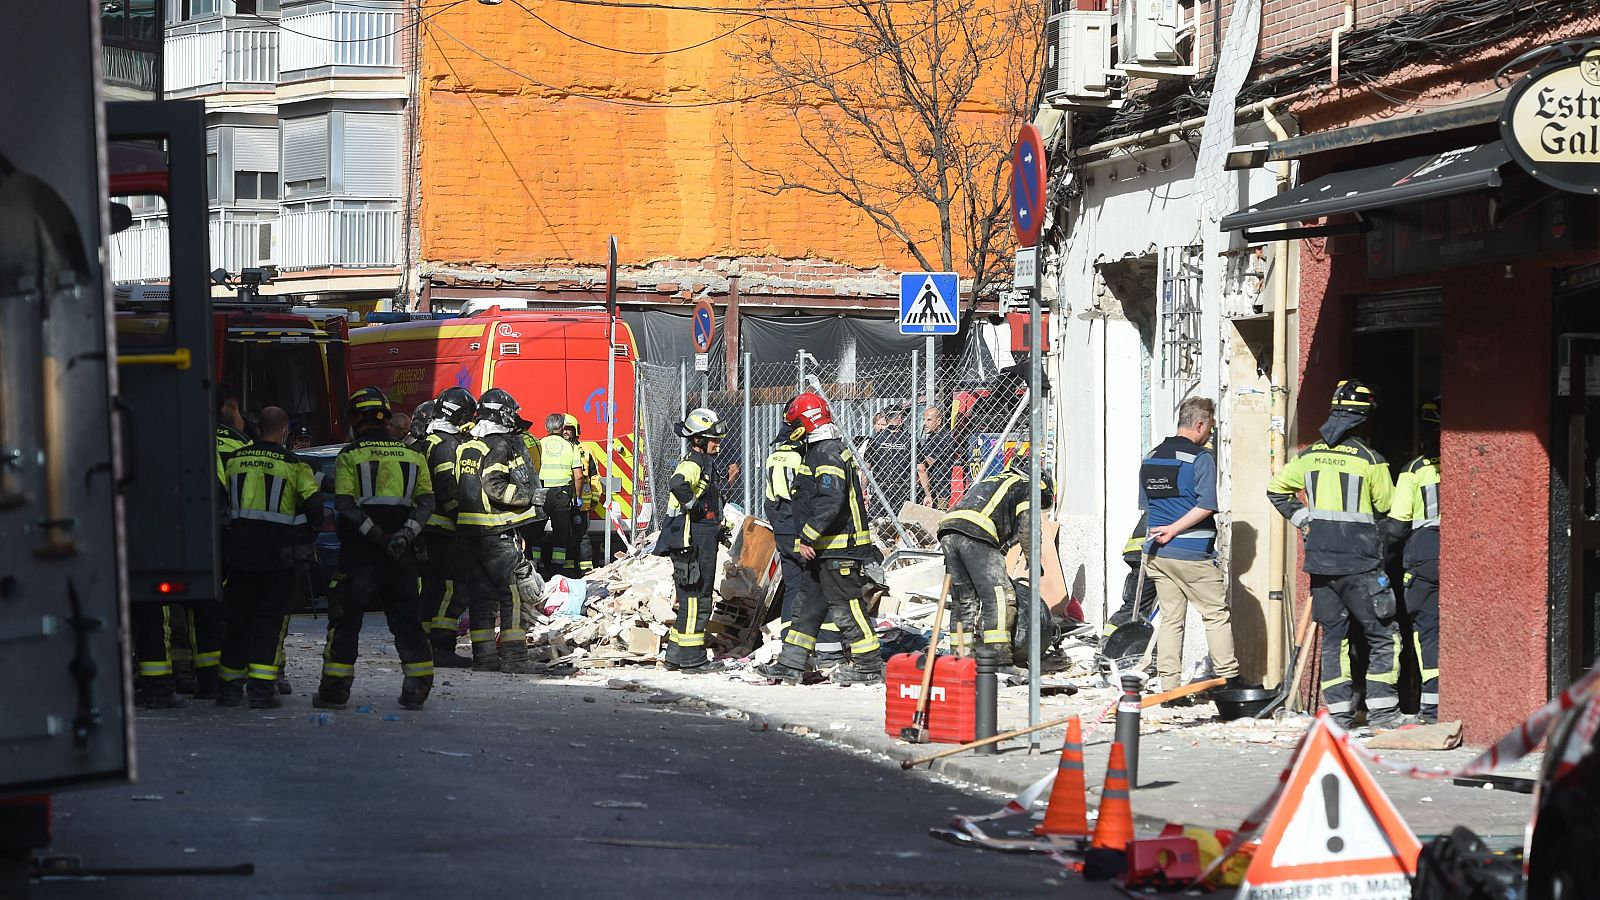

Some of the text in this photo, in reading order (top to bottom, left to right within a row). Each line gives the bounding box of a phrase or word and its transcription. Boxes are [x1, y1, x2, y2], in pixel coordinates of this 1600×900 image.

[393, 368, 426, 382] BOMBEROS
[395, 383, 419, 394] MADRID
[236, 449, 286, 460] BOMBEROS
[1311, 443, 1359, 455] BOMEROS
[240, 460, 274, 469] MADRID
[1314, 458, 1346, 467] MADRID
[900, 683, 946, 702] HITI
